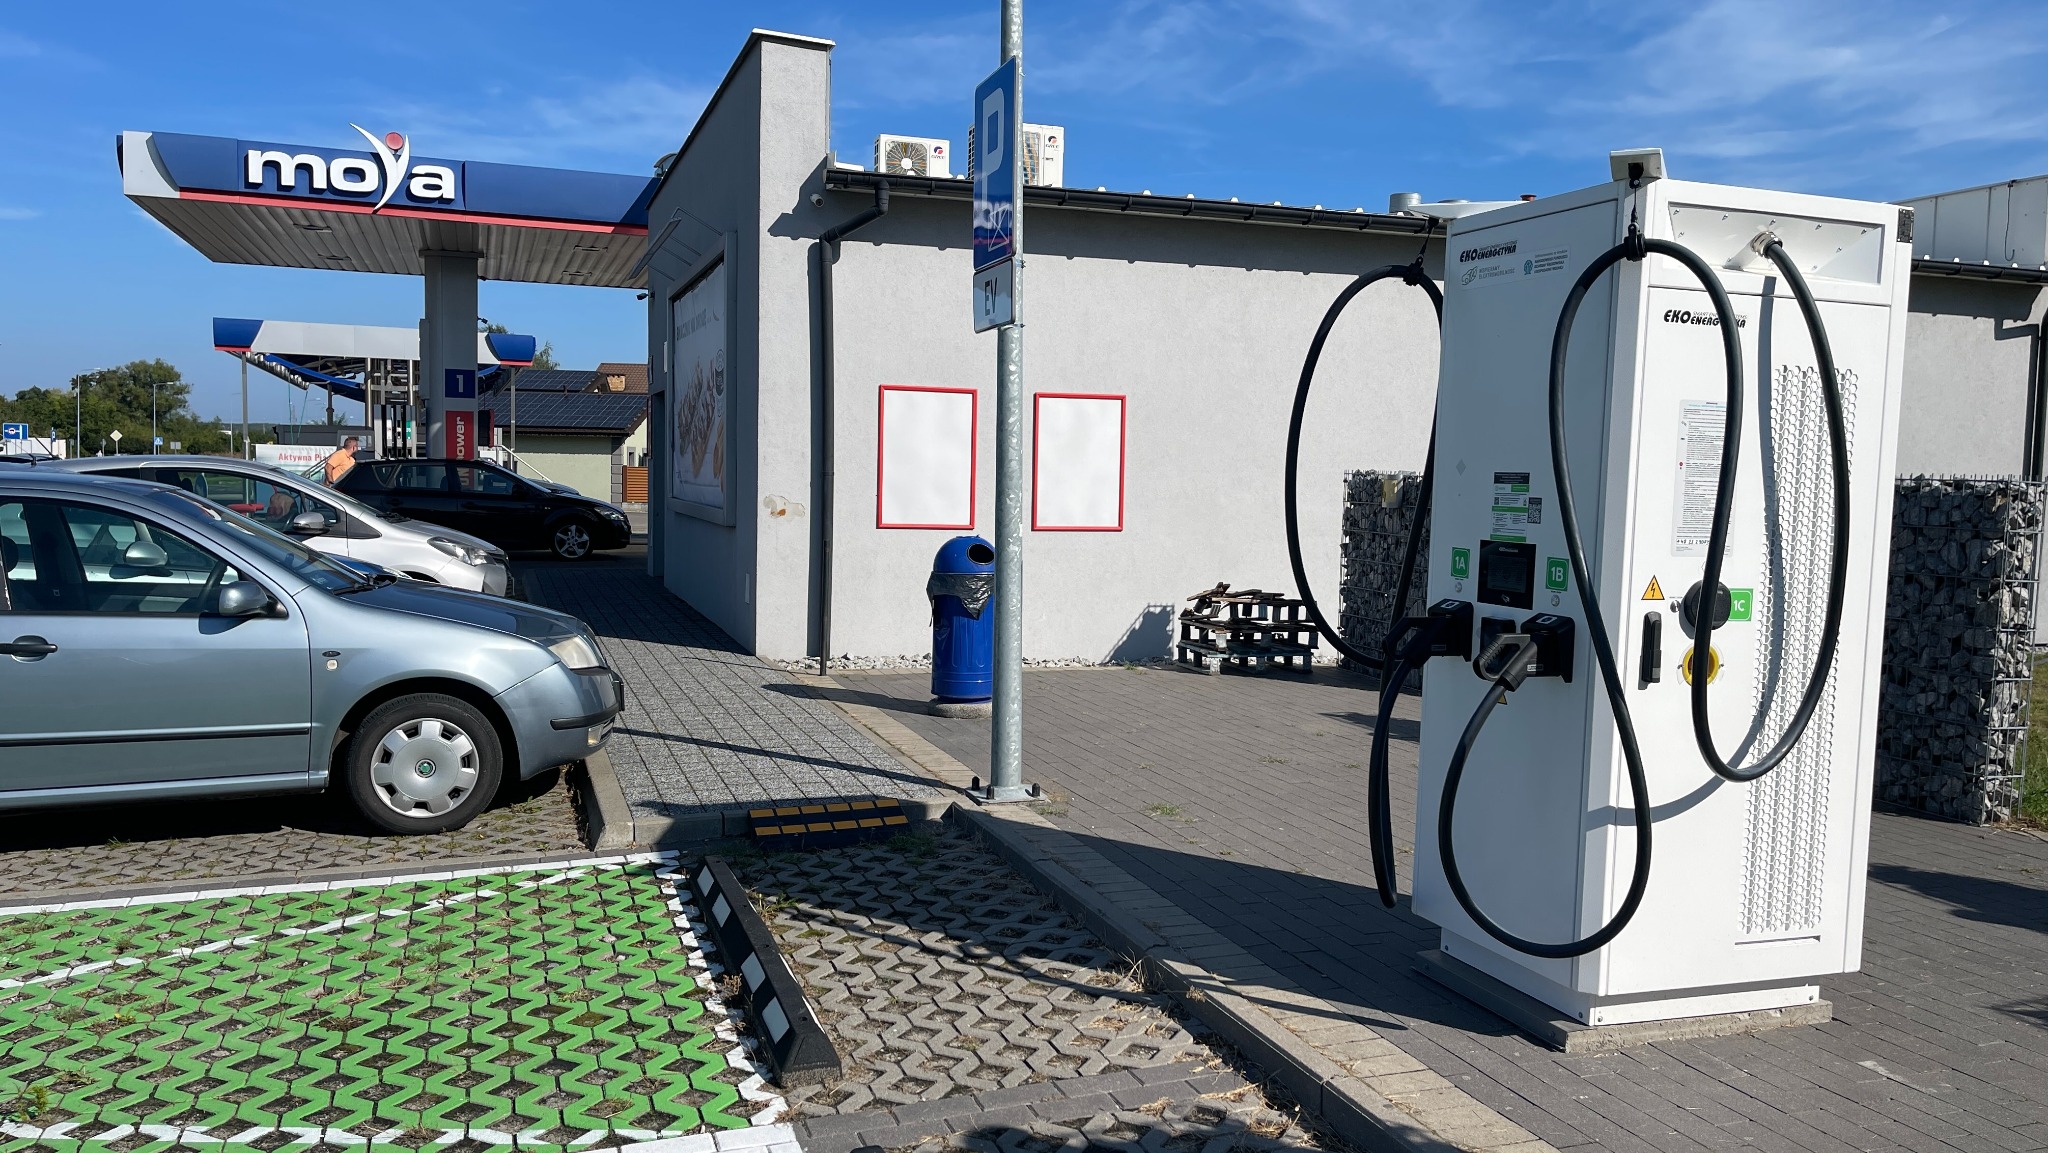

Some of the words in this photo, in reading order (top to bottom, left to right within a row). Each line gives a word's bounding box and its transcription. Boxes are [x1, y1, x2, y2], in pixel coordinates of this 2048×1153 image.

[982, 88, 1005, 211] P
[248, 123, 456, 212] moya
[984, 277, 998, 317] EV
[456, 374, 464, 393] 1
[278, 453, 312, 463] Aktywna
[1455, 556, 1466, 570] 1A
[1551, 566, 1564, 582] 1B
[1733, 599, 1746, 612] 1C
